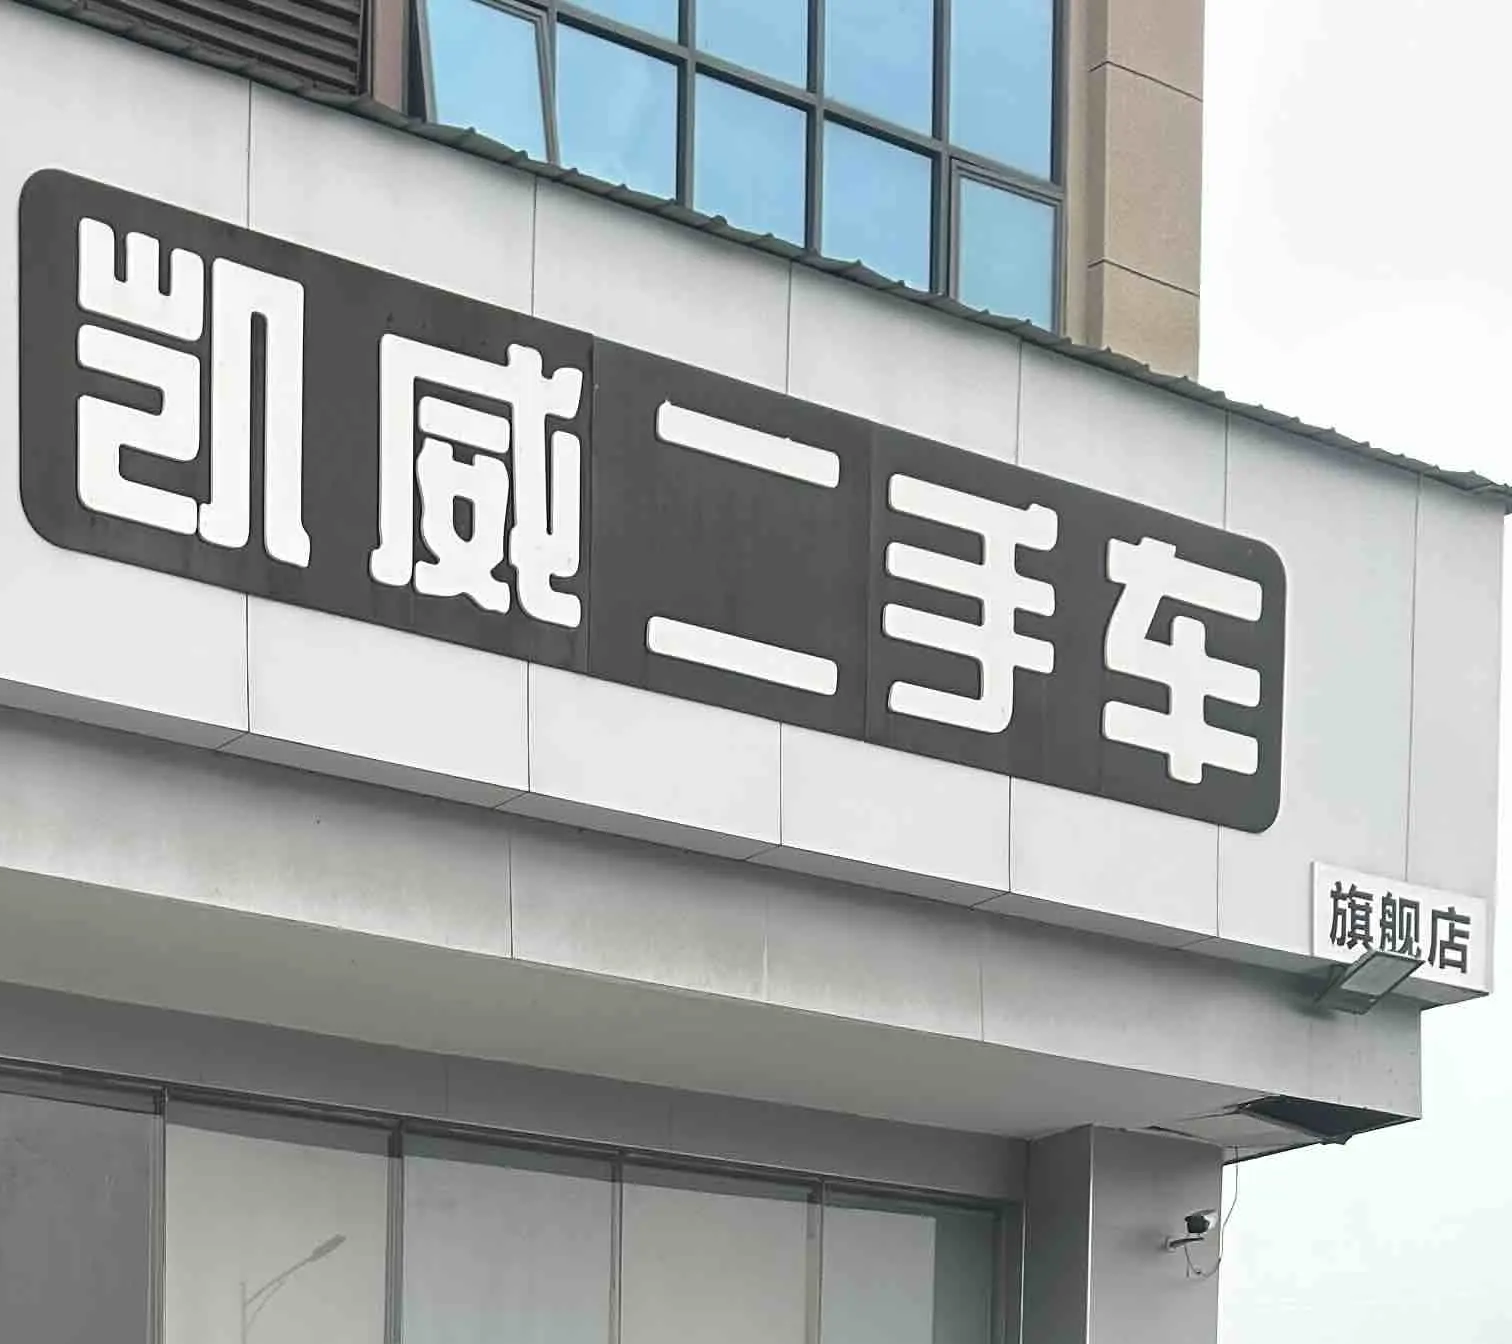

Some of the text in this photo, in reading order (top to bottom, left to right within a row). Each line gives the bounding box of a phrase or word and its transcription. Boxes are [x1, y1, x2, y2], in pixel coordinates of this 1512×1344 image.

[77, 217, 1263, 784] 凯威二手车
[1329, 881, 1472, 975] 旗舰店
